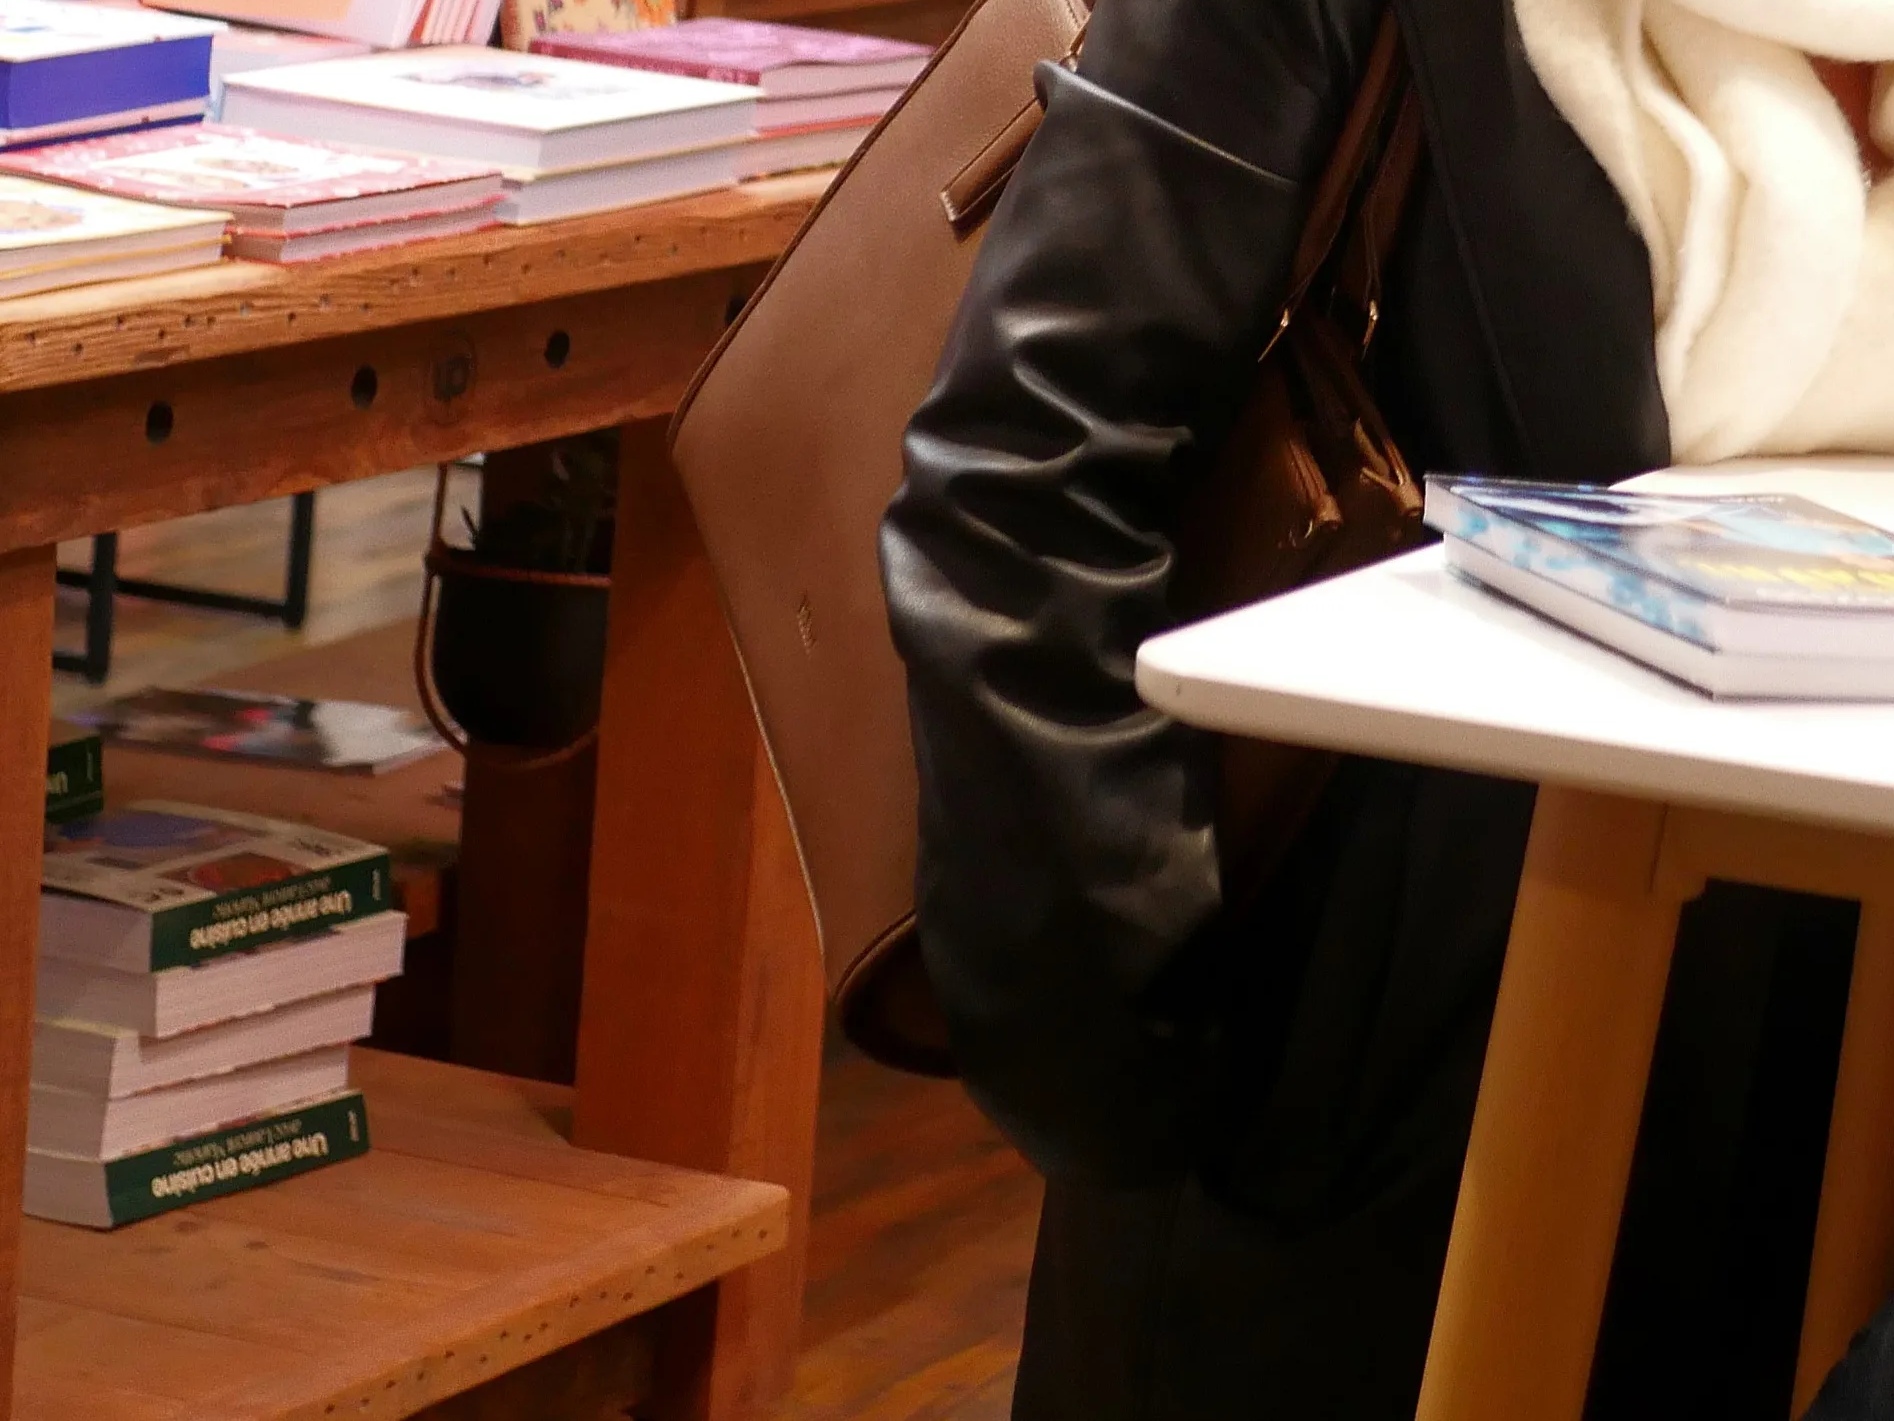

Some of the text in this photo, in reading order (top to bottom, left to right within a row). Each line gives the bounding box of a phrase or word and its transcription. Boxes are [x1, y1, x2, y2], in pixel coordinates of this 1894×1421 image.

[238, 1142, 292, 1177] année
[291, 1131, 330, 1158] Une
[151, 1163, 215, 1198] cuisine
